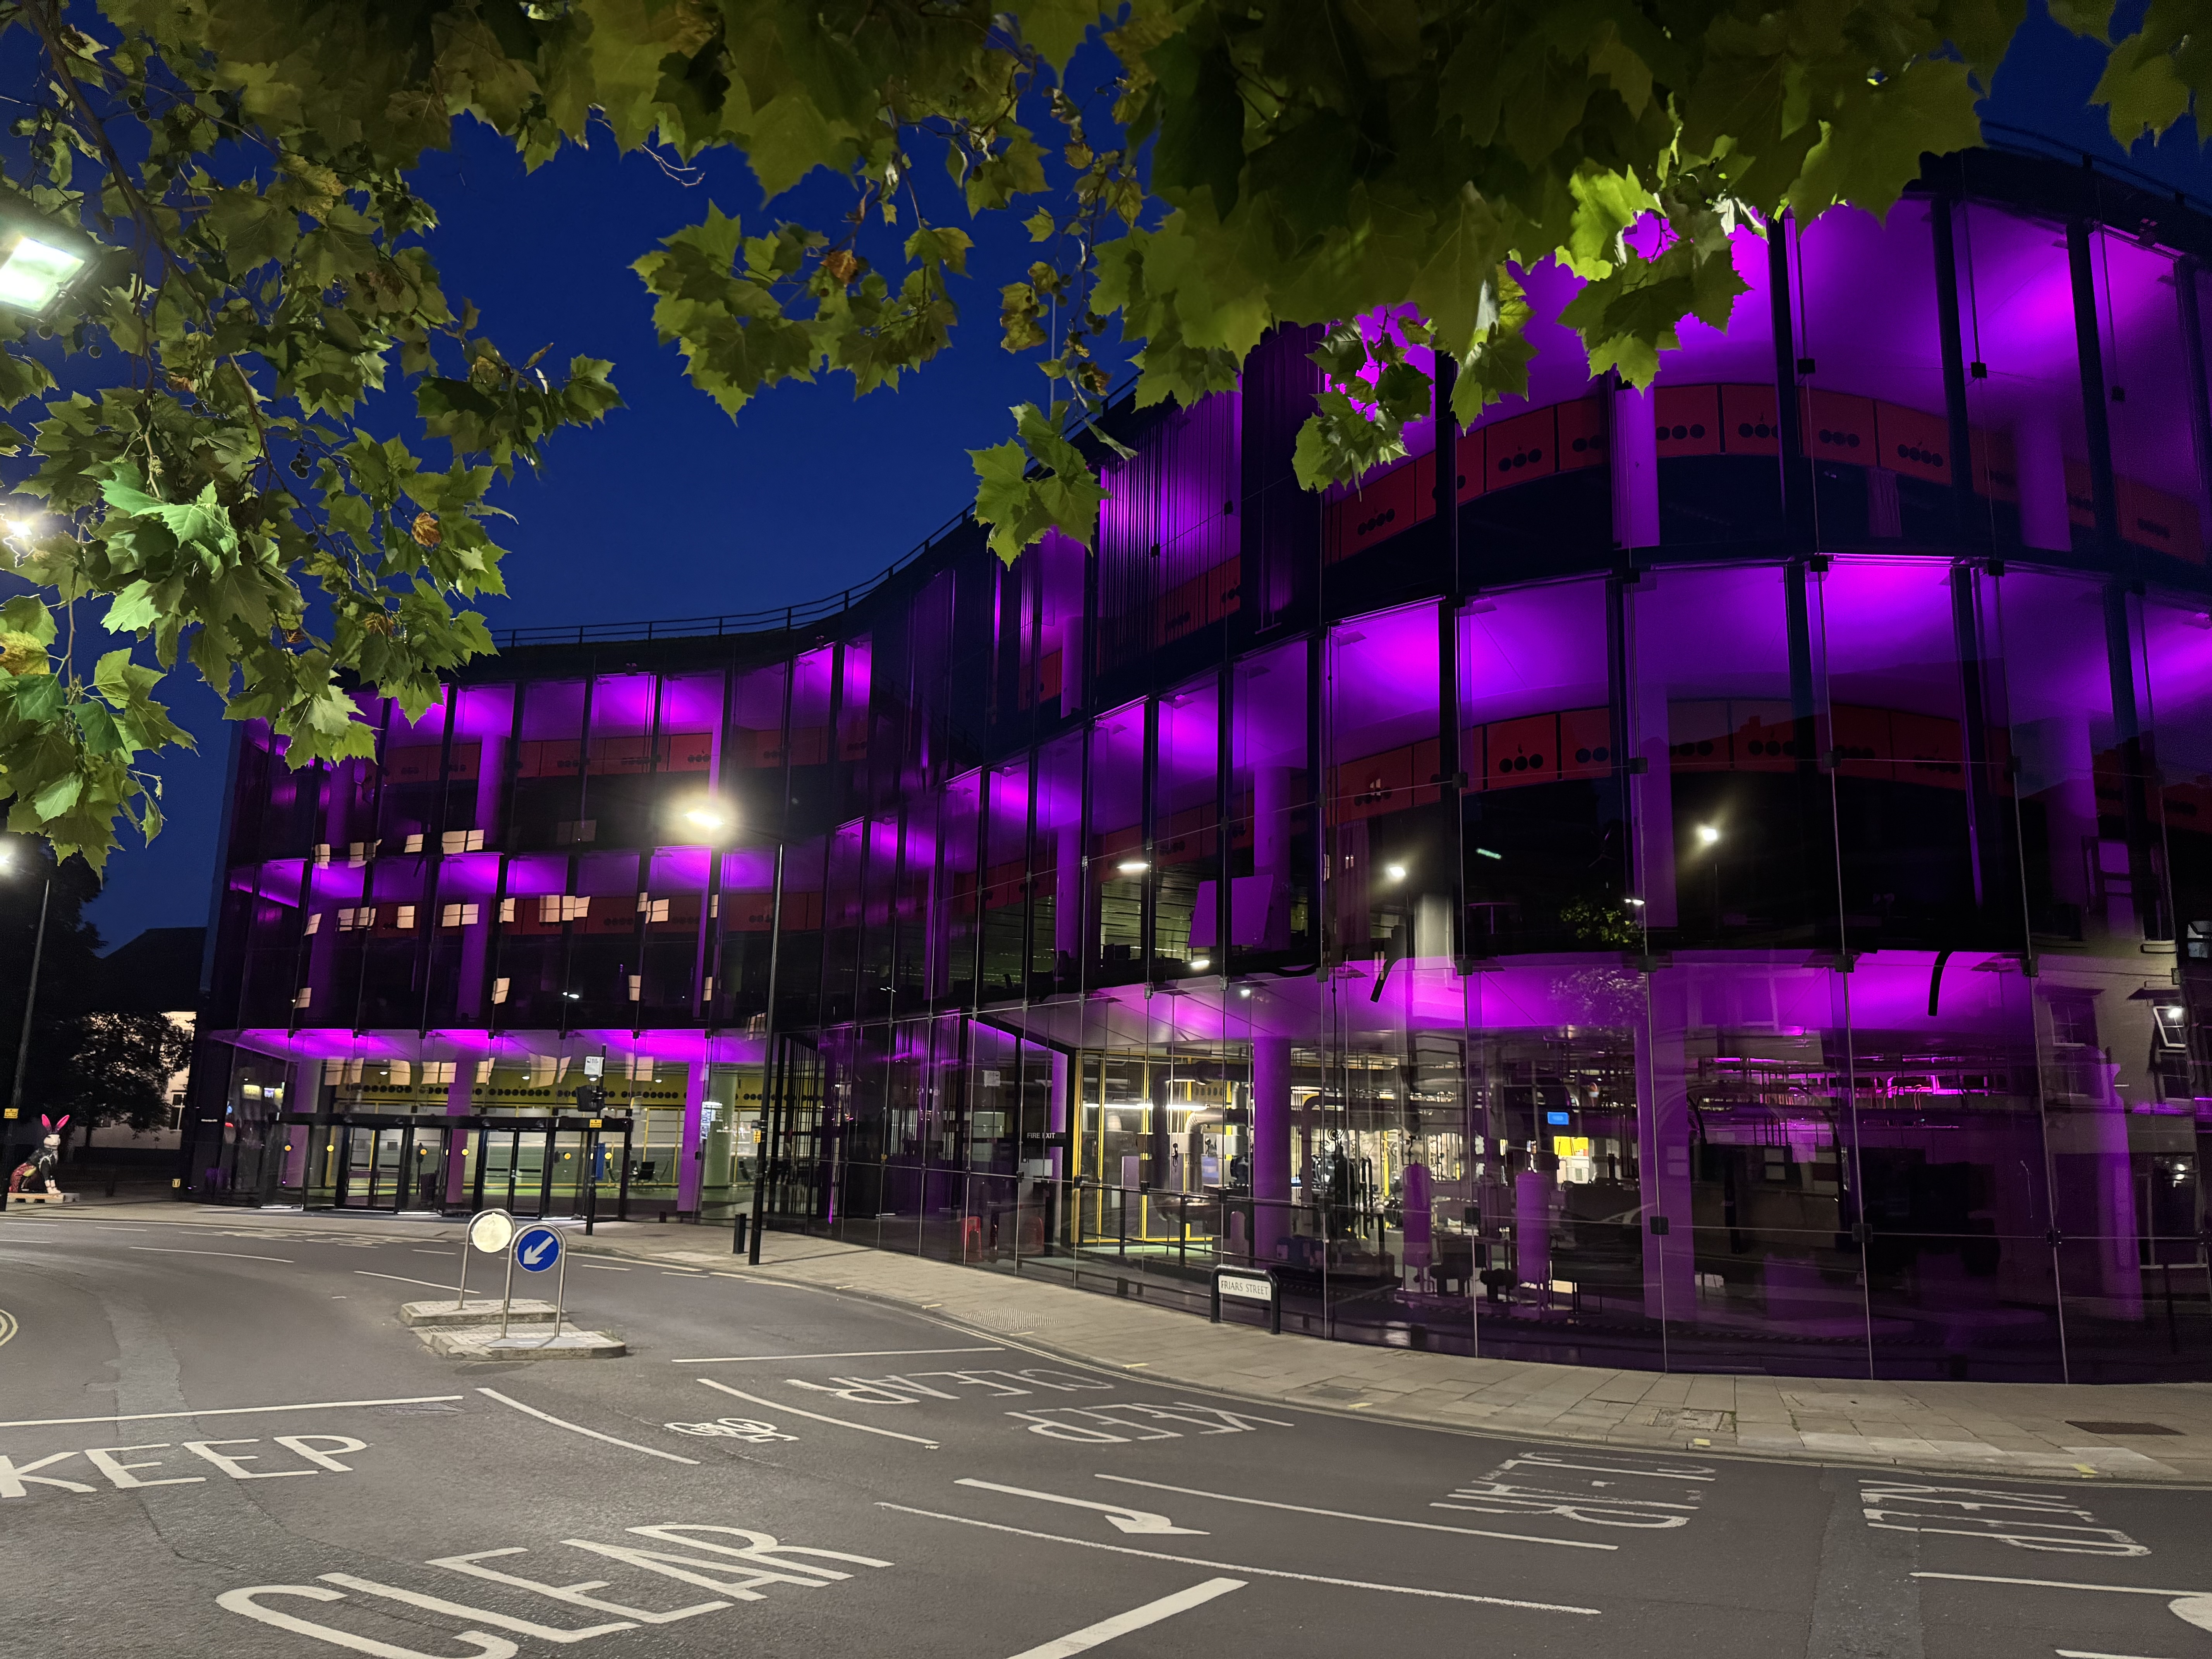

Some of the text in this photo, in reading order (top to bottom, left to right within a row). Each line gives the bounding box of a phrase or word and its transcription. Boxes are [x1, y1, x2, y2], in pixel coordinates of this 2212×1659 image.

[1221, 1280, 1269, 1295] FRIARS STREET
[784, 1369, 1114, 1405] CLEAR
[1004, 1402, 1295, 1443] KEEP
[0, 1434, 369, 1498] KEEP
[1858, 1480, 2152, 1557] KEEP
[215, 1524, 895, 1659] CLEAR
